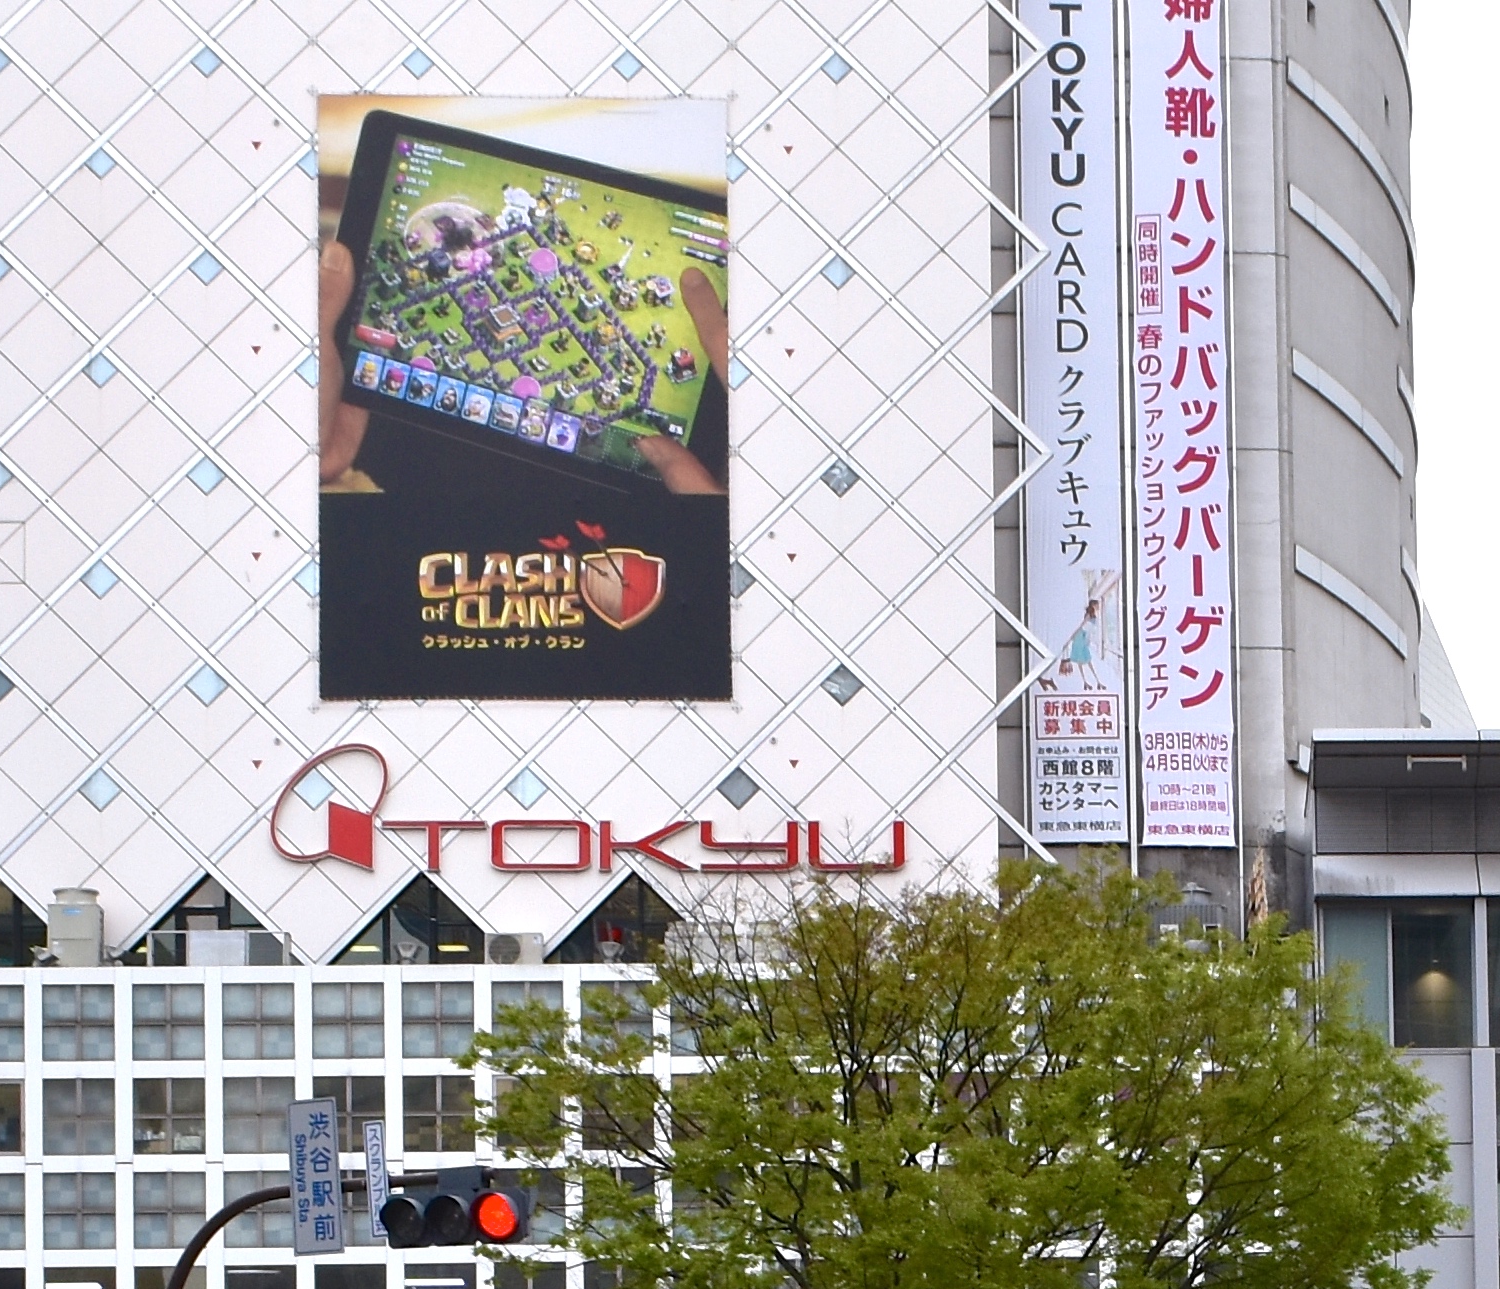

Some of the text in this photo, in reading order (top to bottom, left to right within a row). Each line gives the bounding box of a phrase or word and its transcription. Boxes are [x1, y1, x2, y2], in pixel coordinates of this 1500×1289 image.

[1047, 3, 1089, 354] TOKYU CARD
[1138, 222, 1160, 308] 同時開催
[1056, 364, 1093, 566] クラブキュウ
[418, 550, 578, 598] CLASH
[421, 591, 584, 629] of CLANS
[421, 633, 586, 651] クラッシュ・オブ・クラン
[1044, 700, 1111, 717] 新規会員
[1044, 718, 1113, 735] 募集中
[1042, 759, 1114, 776] 西館8階
[1038, 781, 1119, 795] カスタマー
[1038, 797, 1119, 811] センターへ
[1039, 821, 1121, 832] 東急東横店
[1148, 824, 1230, 836] 東急東横店
[381, 820, 906, 871] TOKYU
[294, 1134, 310, 1228] Shibuya Sta.
[308, 1111, 335, 1241] 渋谷駅前
